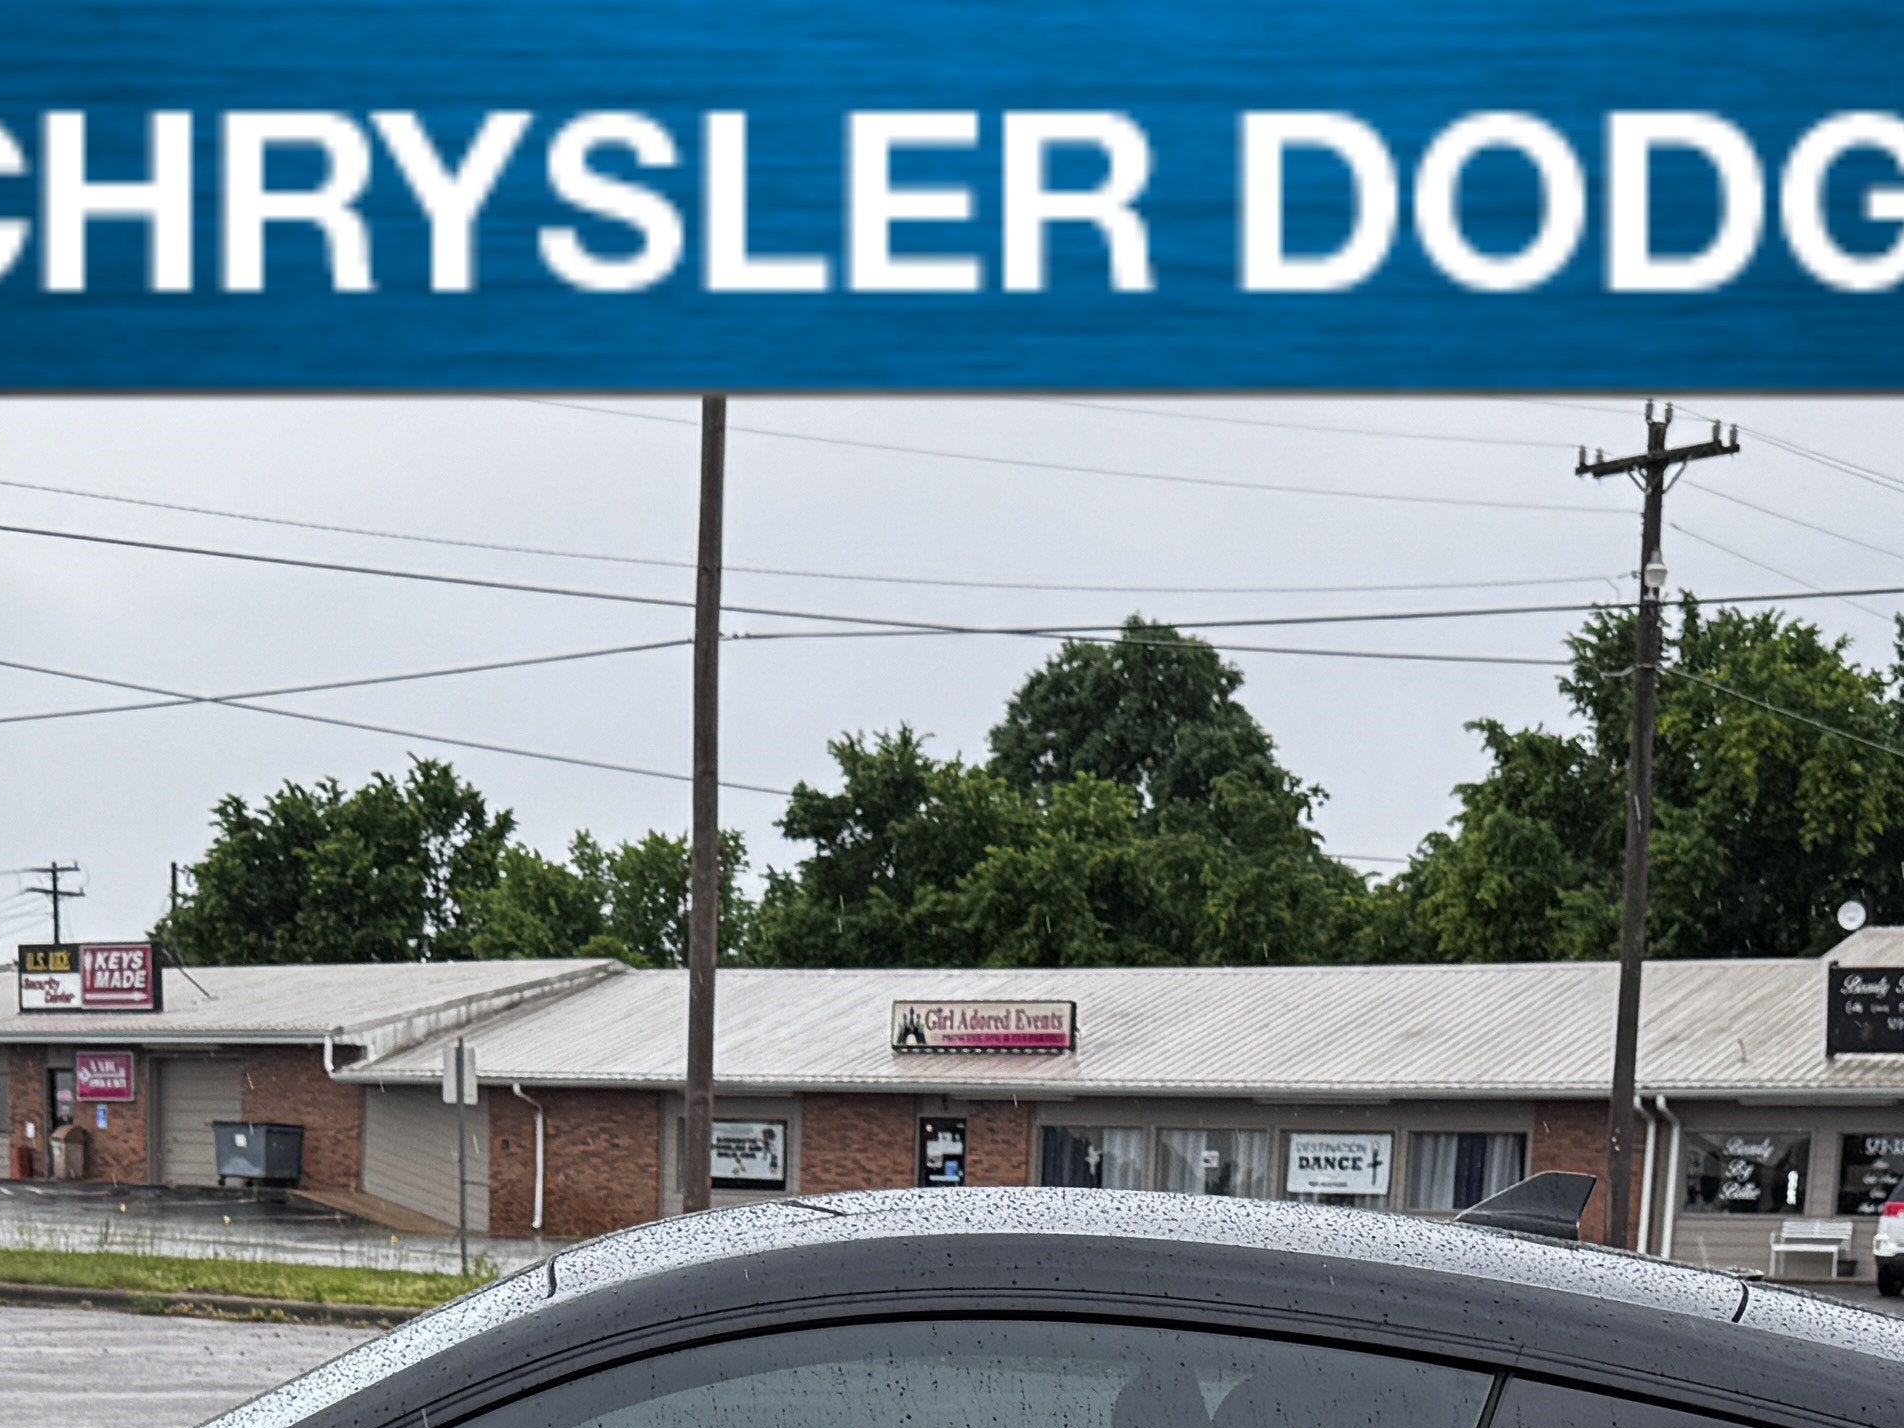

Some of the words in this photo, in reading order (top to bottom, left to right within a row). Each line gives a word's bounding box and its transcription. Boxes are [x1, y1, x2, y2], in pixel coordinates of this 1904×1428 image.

[95, 951, 144, 970] KEYS
[94, 970, 146, 989] MADE
[925, 1006, 954, 1030] Girl
[957, 1008, 1011, 1030] Adored
[1015, 1008, 1063, 1030] Events
[1299, 1156, 1363, 1171] DANCE
